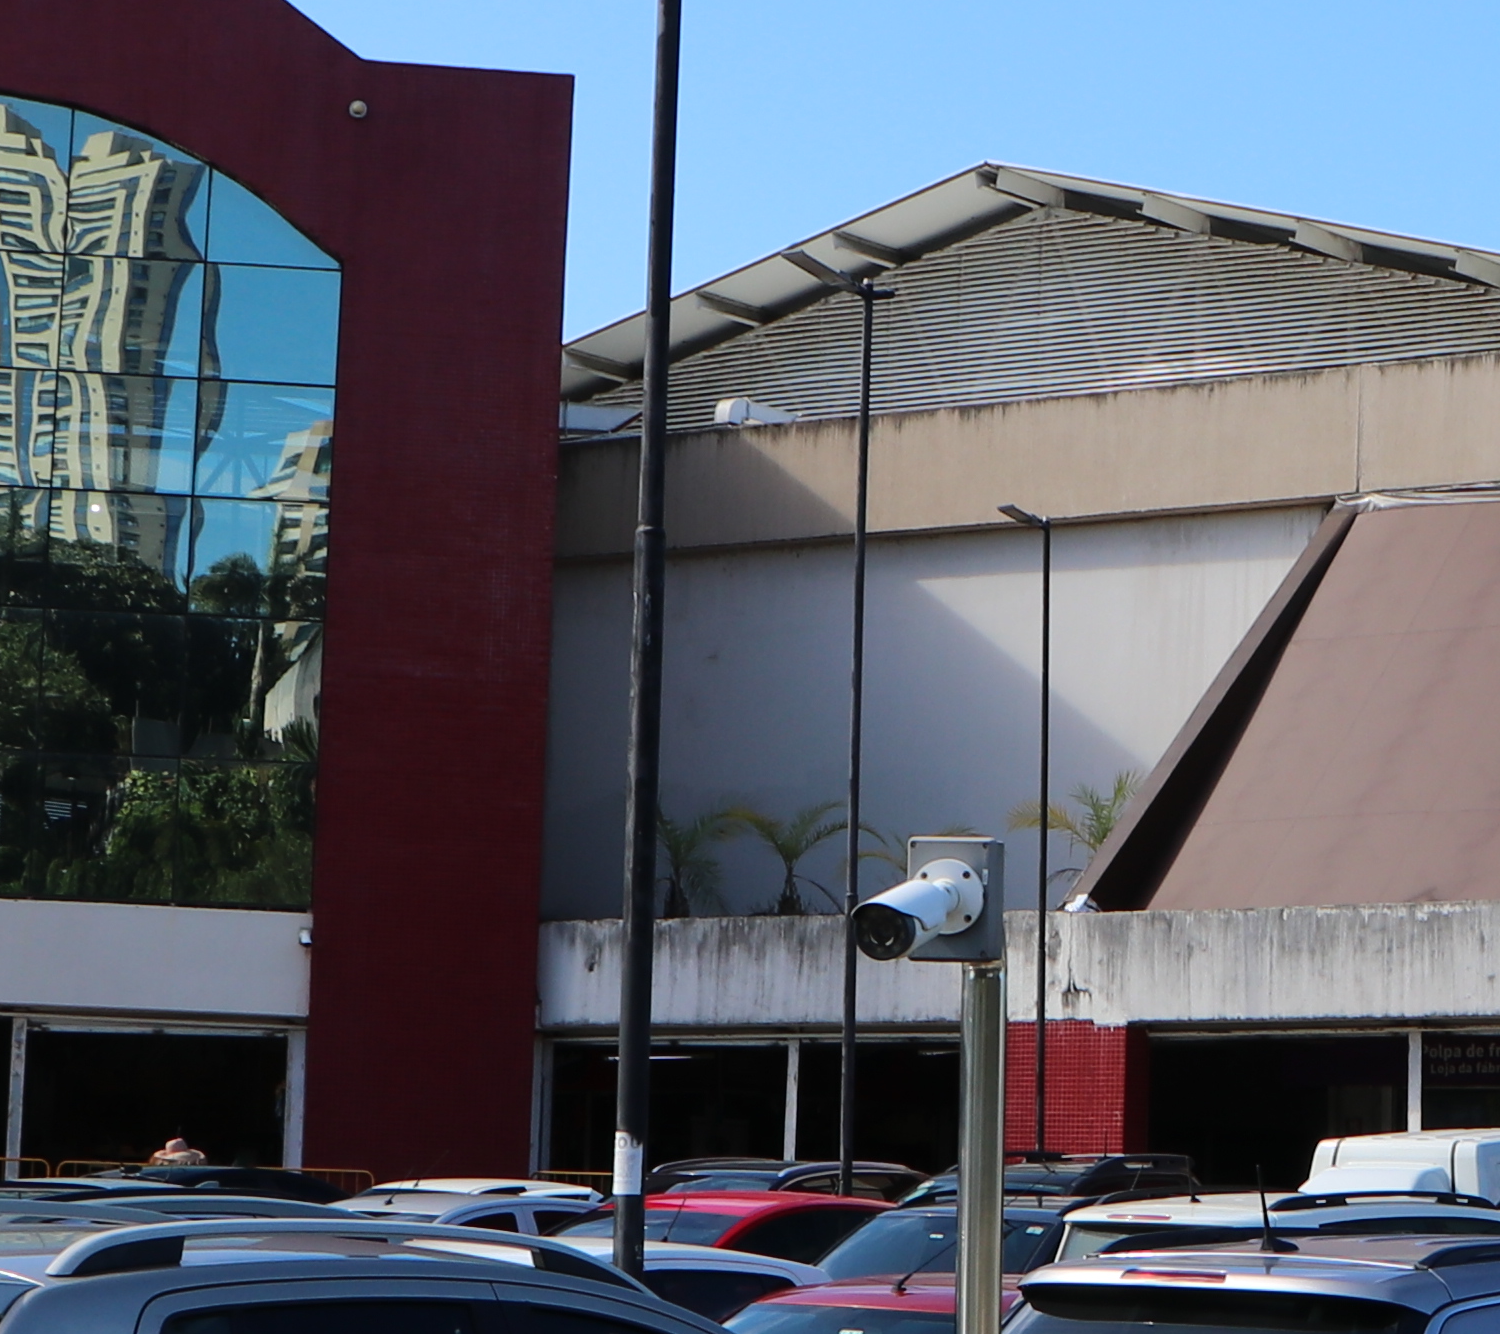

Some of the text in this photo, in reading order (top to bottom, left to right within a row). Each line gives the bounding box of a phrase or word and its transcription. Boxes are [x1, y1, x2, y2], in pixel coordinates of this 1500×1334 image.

[1465, 1042, 1485, 1058] de
[1430, 1063, 1456, 1077] Loja
[1458, 1061, 1473, 1074] da
